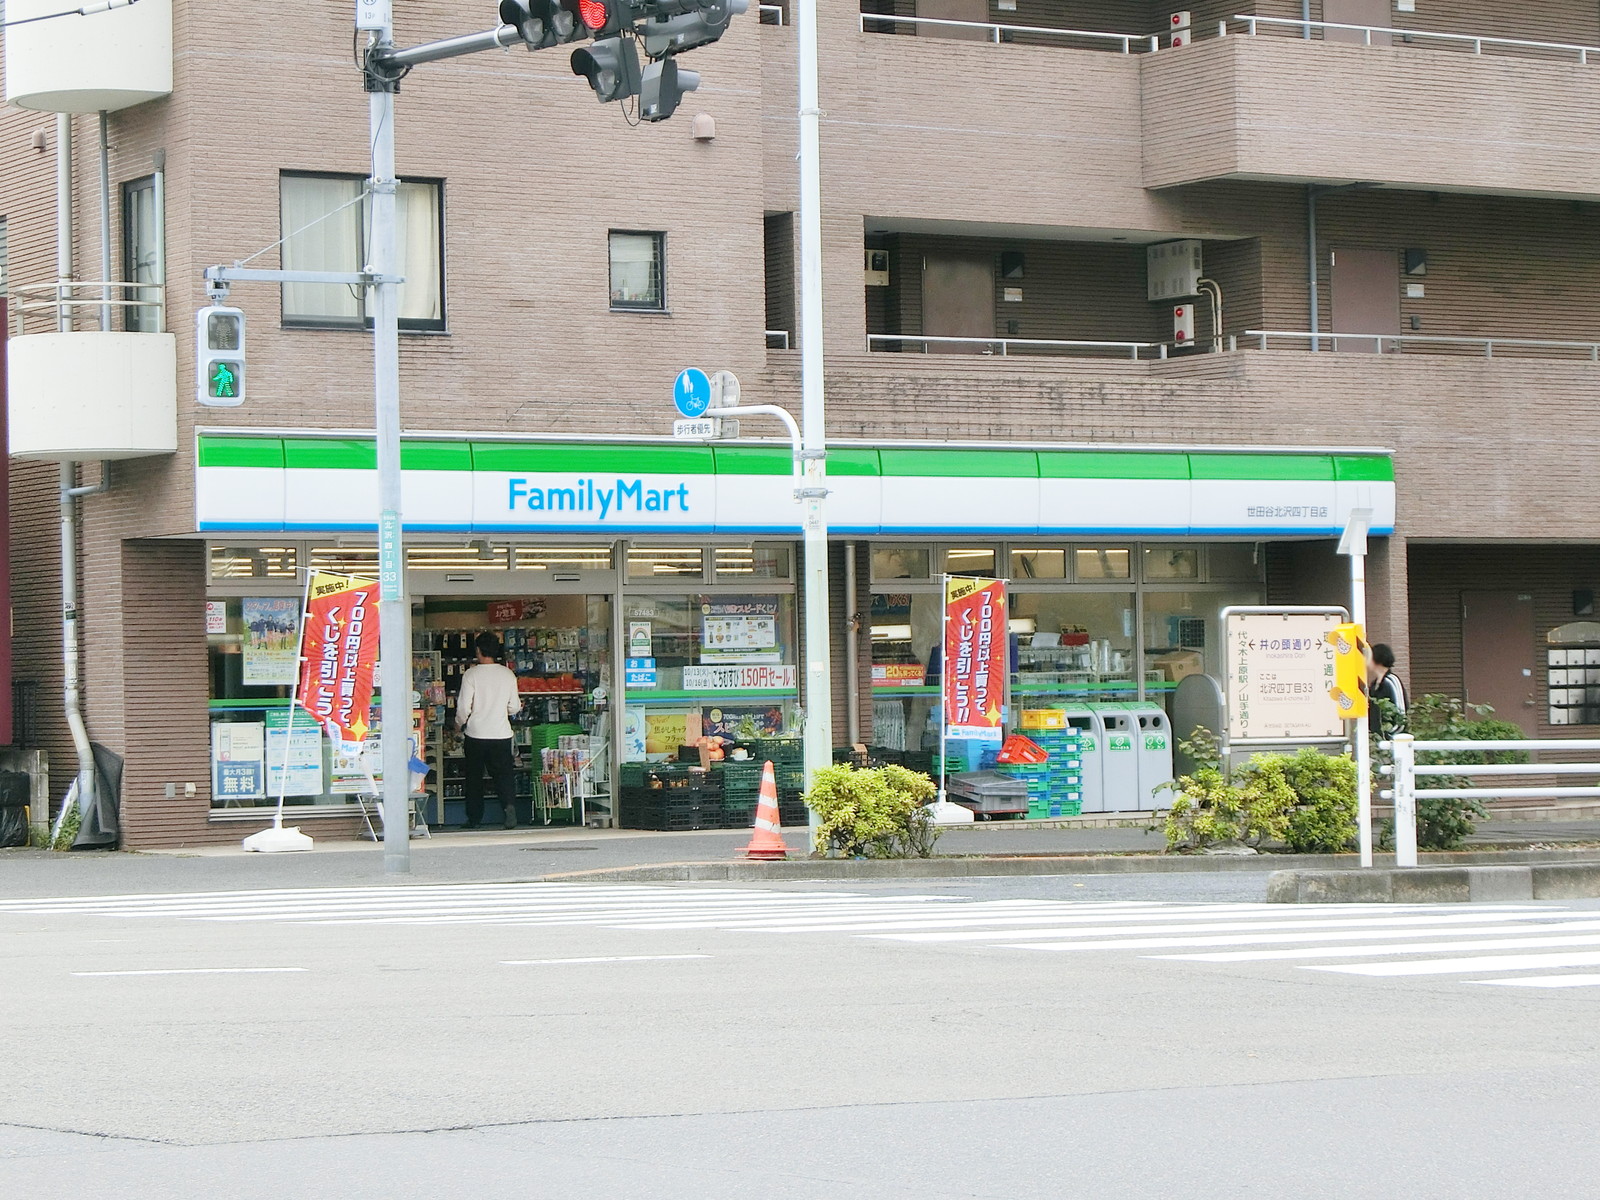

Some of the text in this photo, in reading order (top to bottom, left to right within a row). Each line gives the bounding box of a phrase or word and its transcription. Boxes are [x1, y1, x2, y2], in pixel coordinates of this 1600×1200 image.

[677, 423, 711, 435] 歩行者優先
[509, 478, 689, 520] FamilyMart
[1247, 506, 1328, 518] 世田谷北沢四丁目店
[315, 580, 349, 596] 実施中!
[950, 582, 976, 600] 実施中!
[1260, 639, 1312, 650] 井の頭通り
[631, 673, 652, 682] たばこ
[1260, 683, 1313, 694] 北沢四丁目33
[223, 776, 256, 793] 無料
